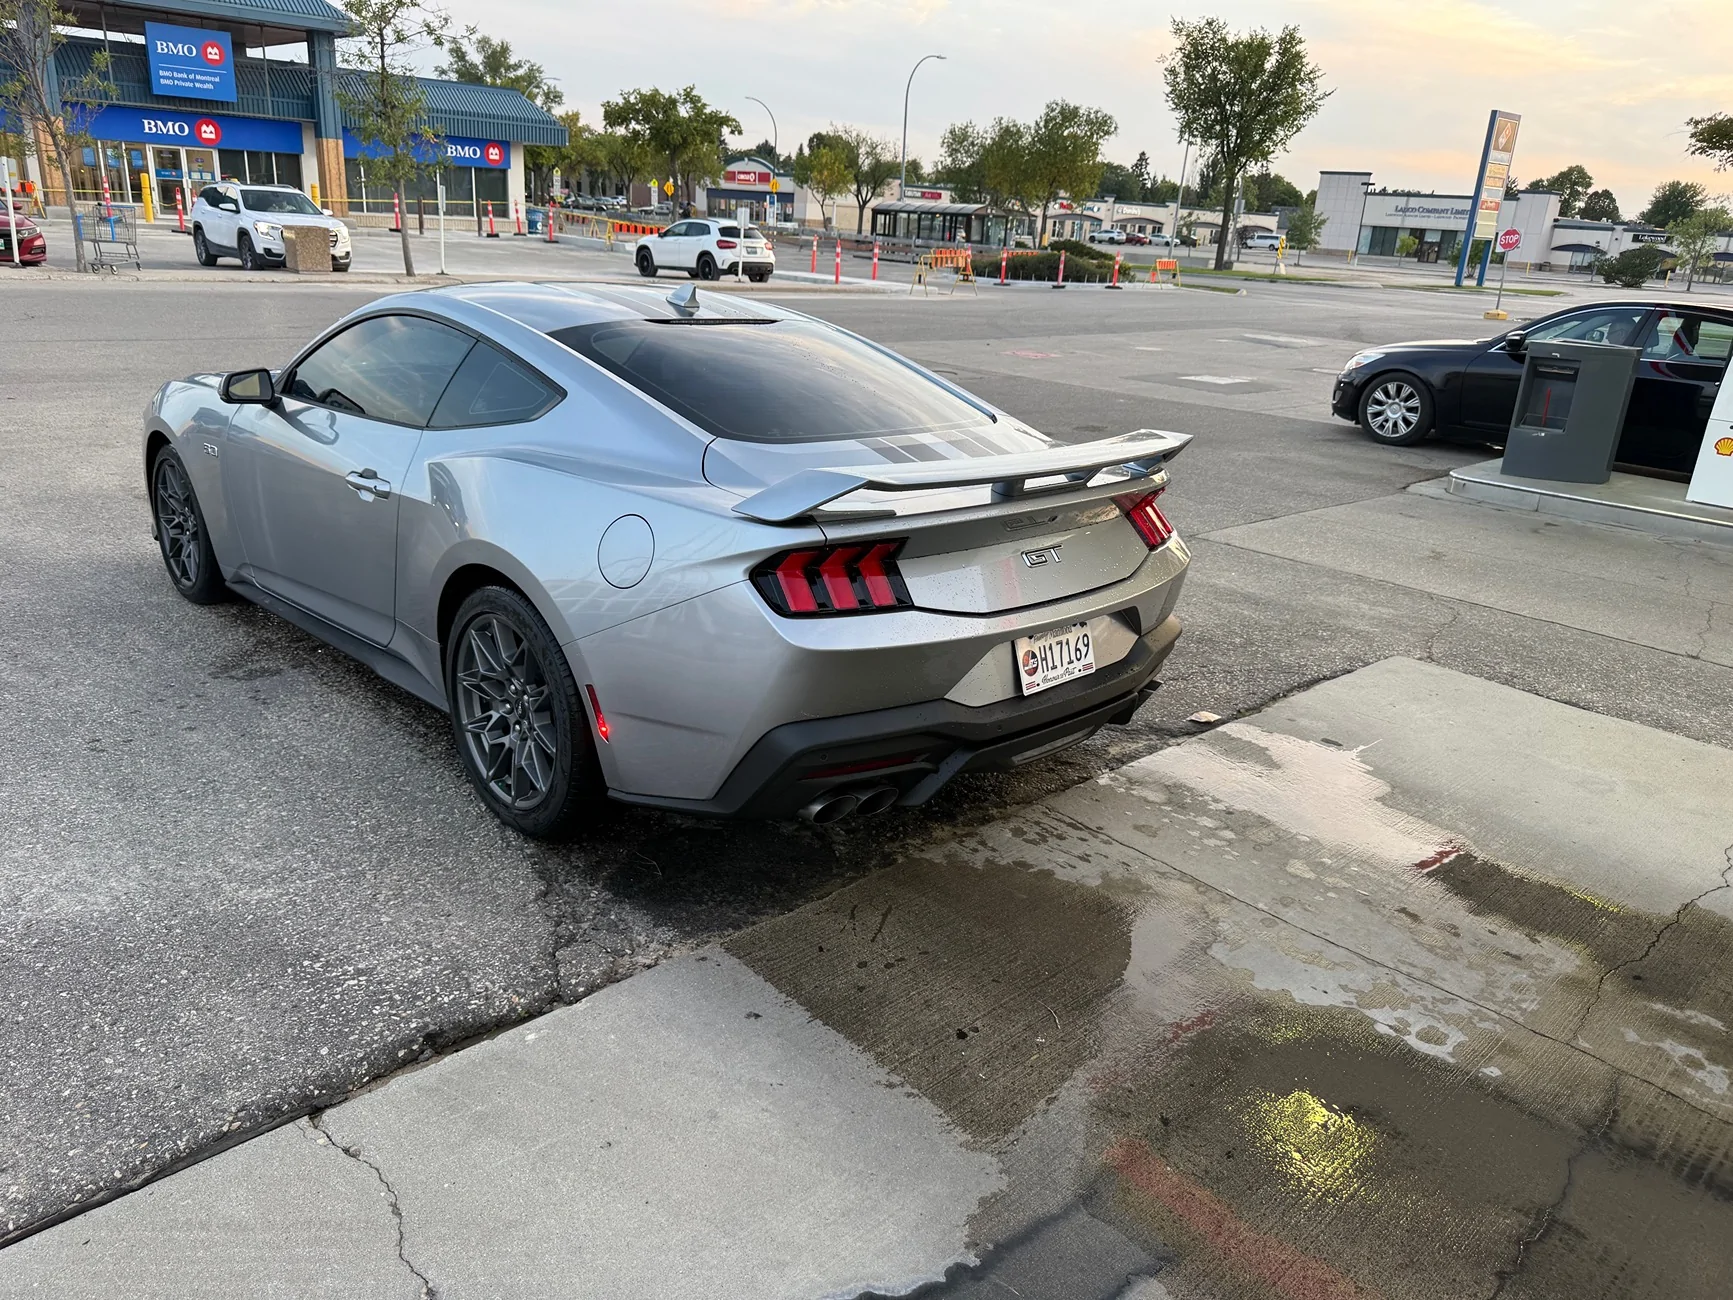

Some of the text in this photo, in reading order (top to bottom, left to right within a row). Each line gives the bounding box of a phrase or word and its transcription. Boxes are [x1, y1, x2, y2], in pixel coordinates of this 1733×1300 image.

[155, 40, 197, 57] BMO
[173, 71, 188, 79] Bank
[195, 74, 220, 82] Montreal
[174, 80, 194, 88] Private
[194, 82, 214, 90] Wealth
[141, 118, 189, 136] BMO
[446, 144, 480, 159] BMO
[1500, 234, 1519, 245] STOP
[1021, 544, 1064, 568] GT
[1038, 633, 1090, 674] H17169
